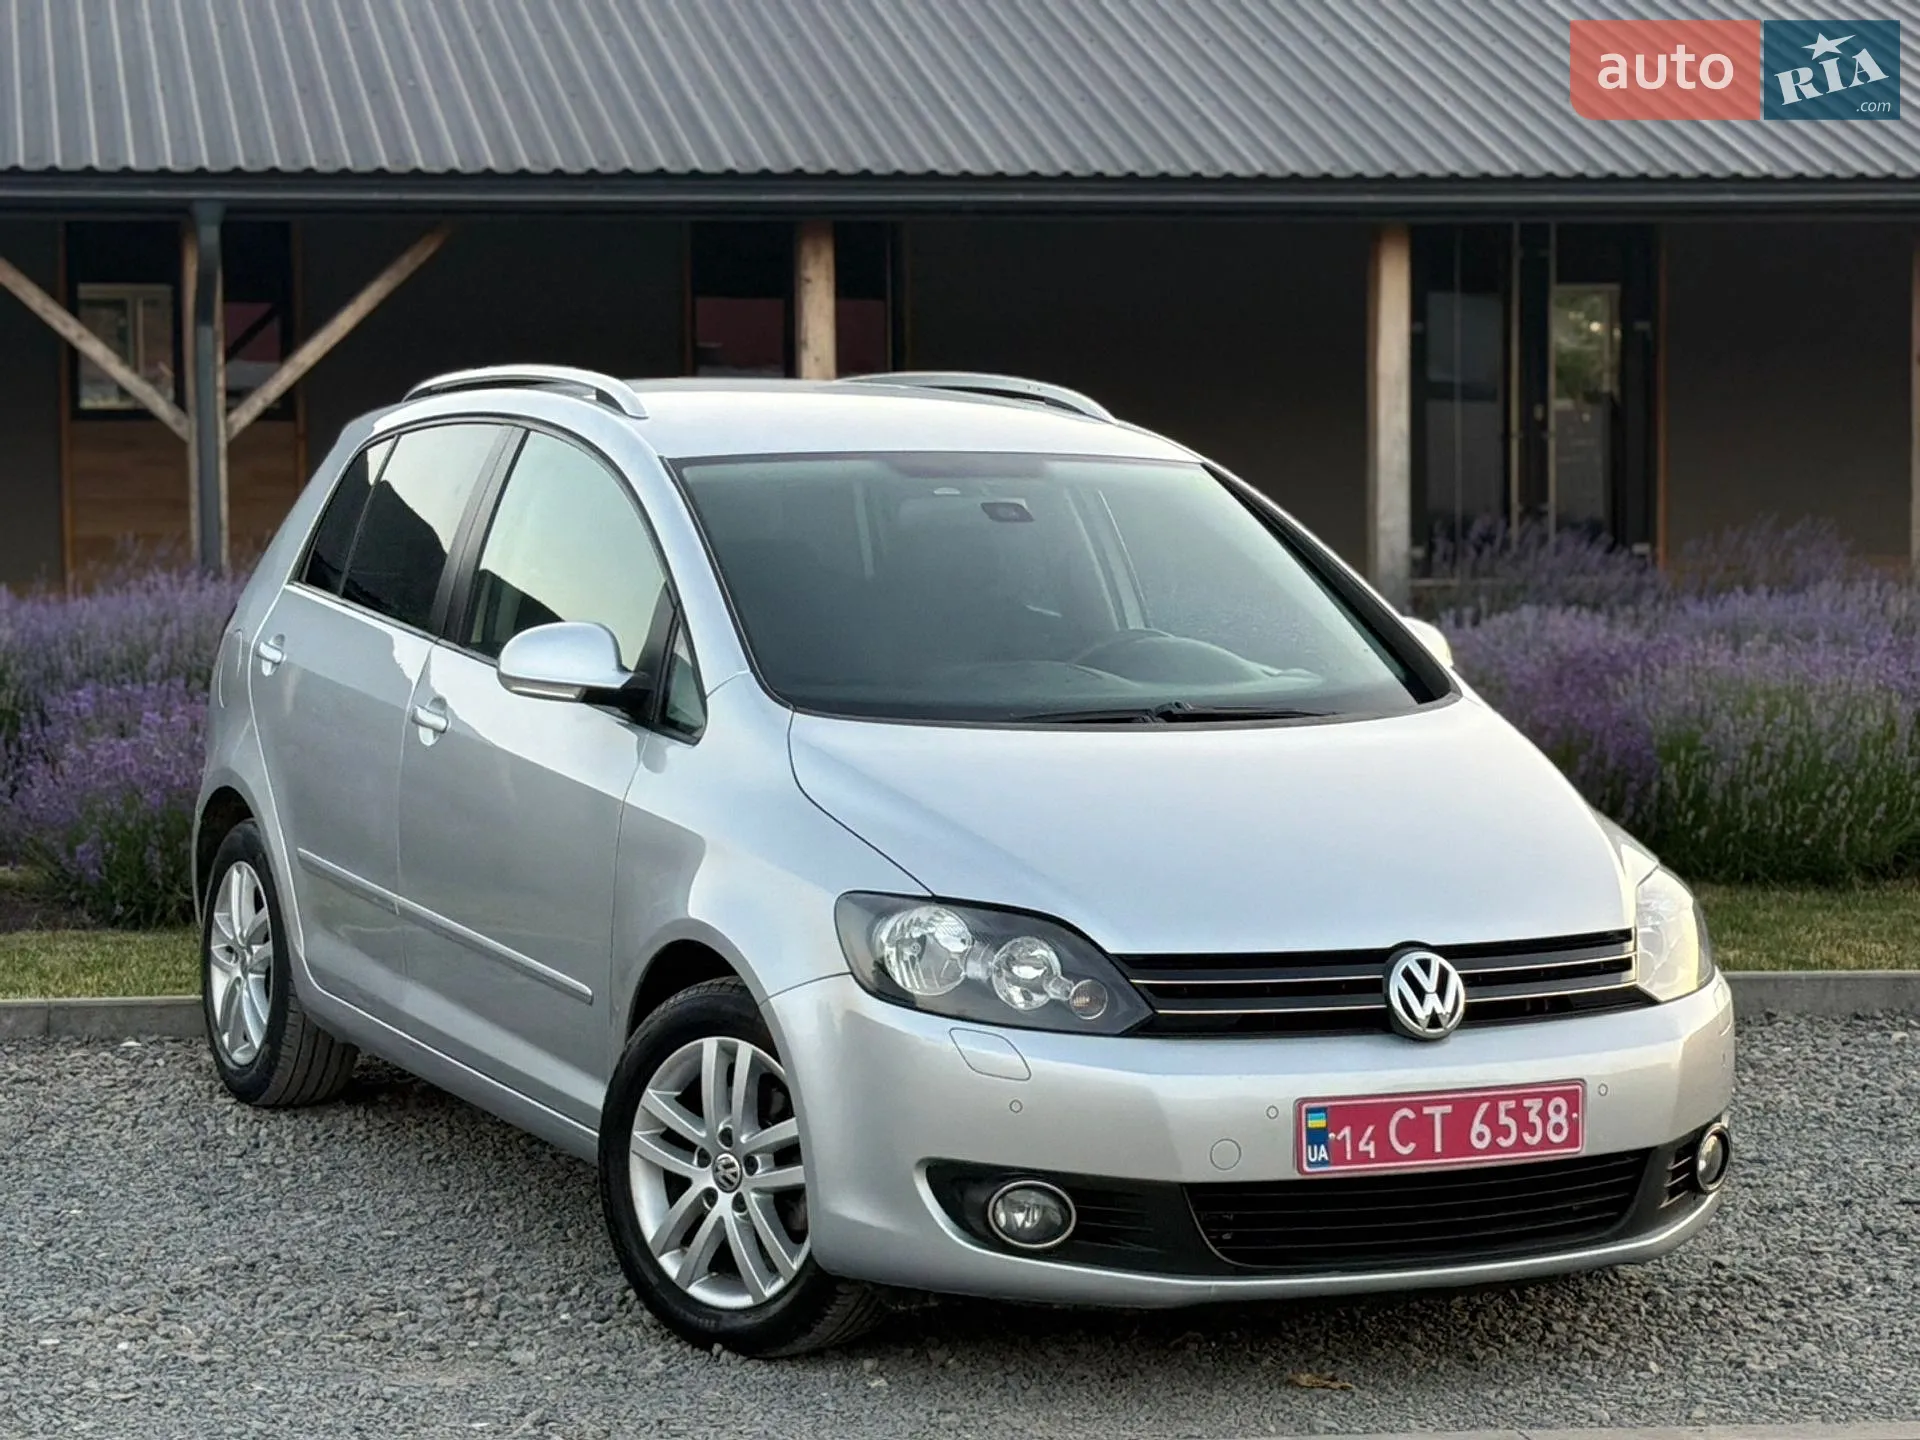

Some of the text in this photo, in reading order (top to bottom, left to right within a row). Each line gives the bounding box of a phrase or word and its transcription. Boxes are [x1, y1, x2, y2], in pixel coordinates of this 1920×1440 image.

[1398, 958, 1459, 1031] VW
[1307, 1144, 1328, 1162] UA
[1336, 1096, 1569, 1160] 14 CT 6538
